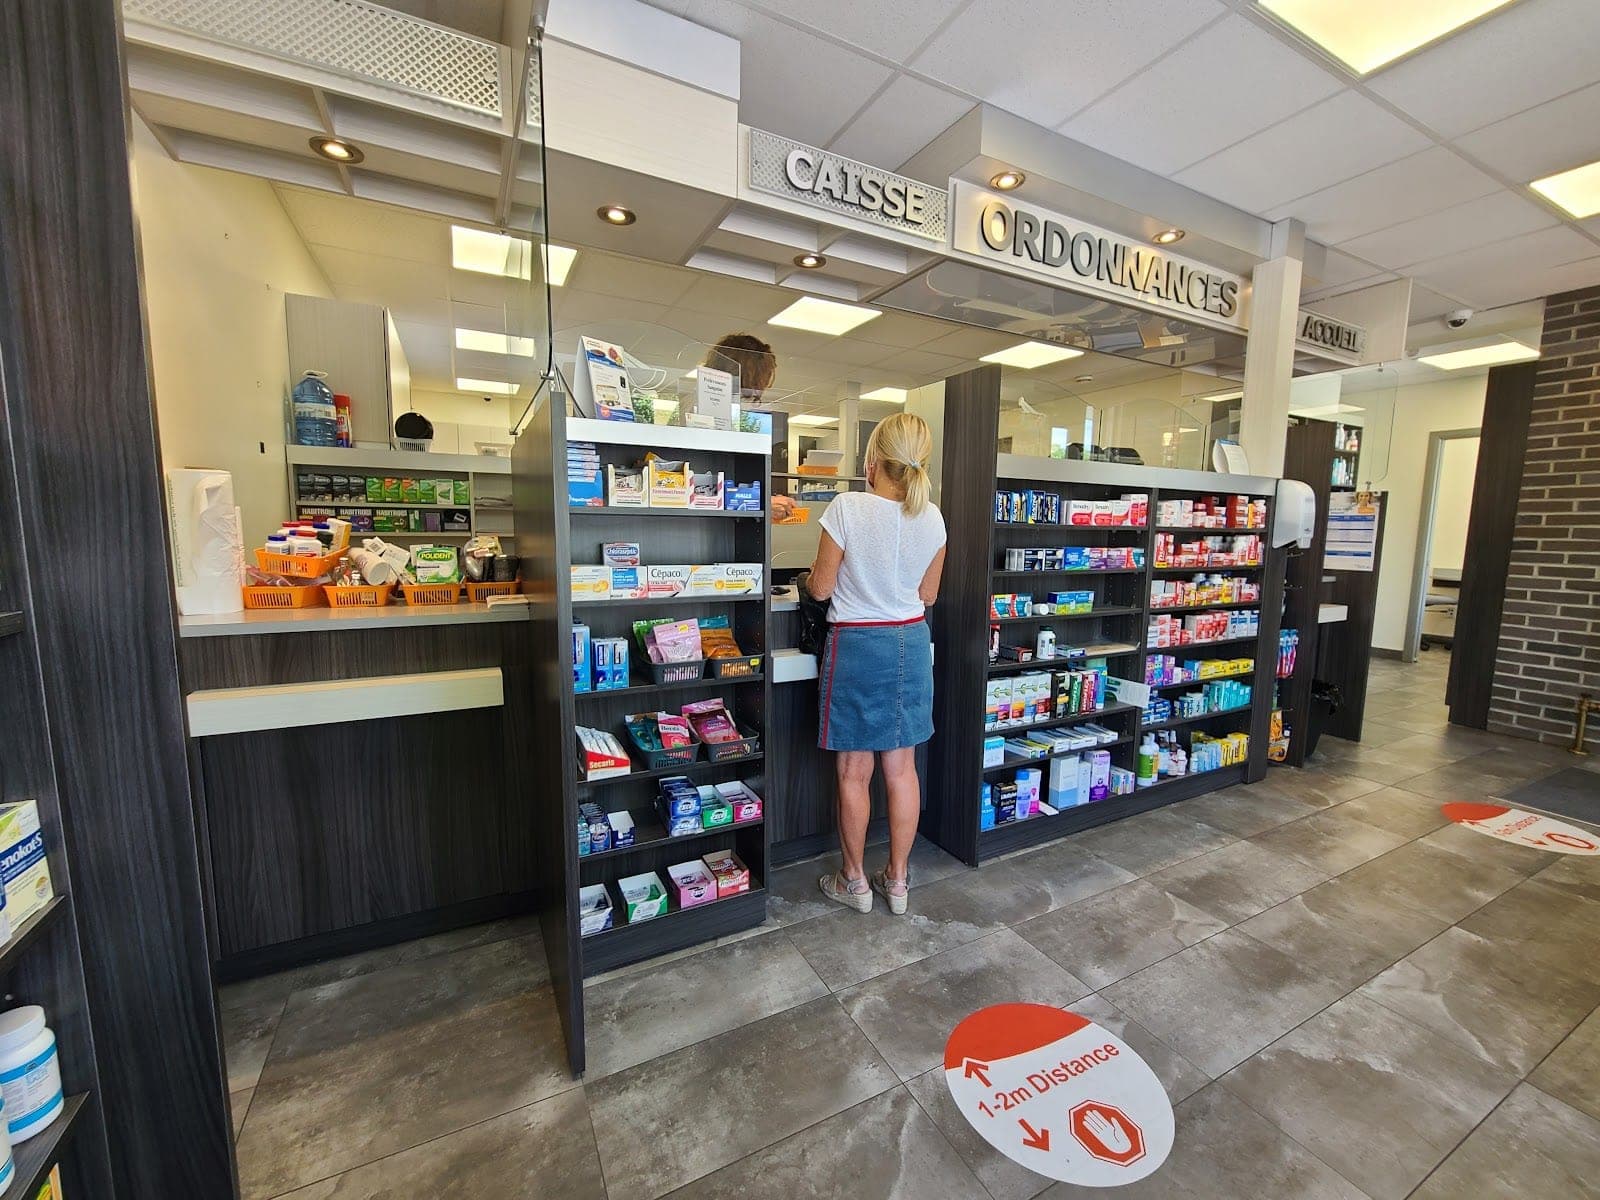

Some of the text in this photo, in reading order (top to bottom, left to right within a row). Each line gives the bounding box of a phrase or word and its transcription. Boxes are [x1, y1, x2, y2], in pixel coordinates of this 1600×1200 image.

[785, 149, 926, 225] CAISSE
[981, 201, 1238, 318] ORDONNANCES
[1302, 316, 1358, 351] ACCUEIL
[978, 1043, 1120, 1119] 1-2m Distance
